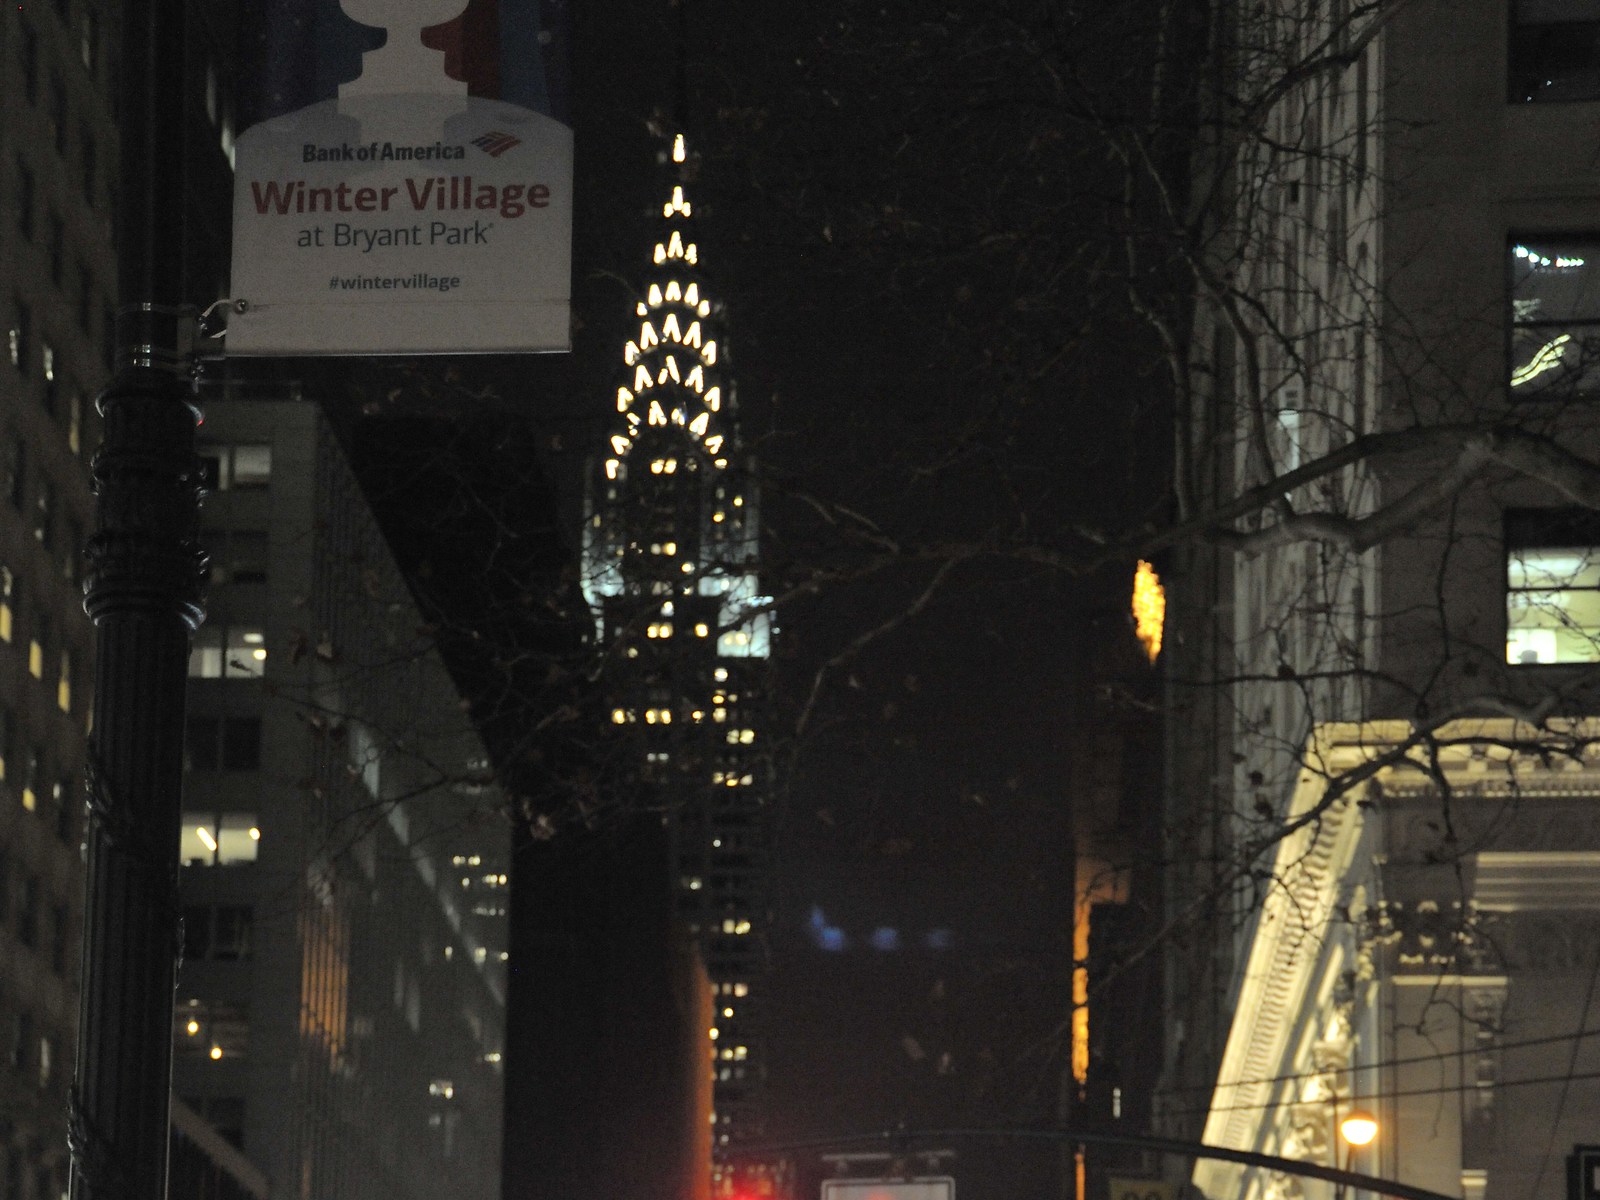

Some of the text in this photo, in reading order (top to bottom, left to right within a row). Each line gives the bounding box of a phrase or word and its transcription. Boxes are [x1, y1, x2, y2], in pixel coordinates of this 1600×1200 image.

[303, 142, 465, 163] Bank of America
[251, 175, 550, 218] Winter Village
[297, 226, 324, 248] at
[333, 223, 419, 253] Bryant
[329, 273, 461, 291] #wintervillage
